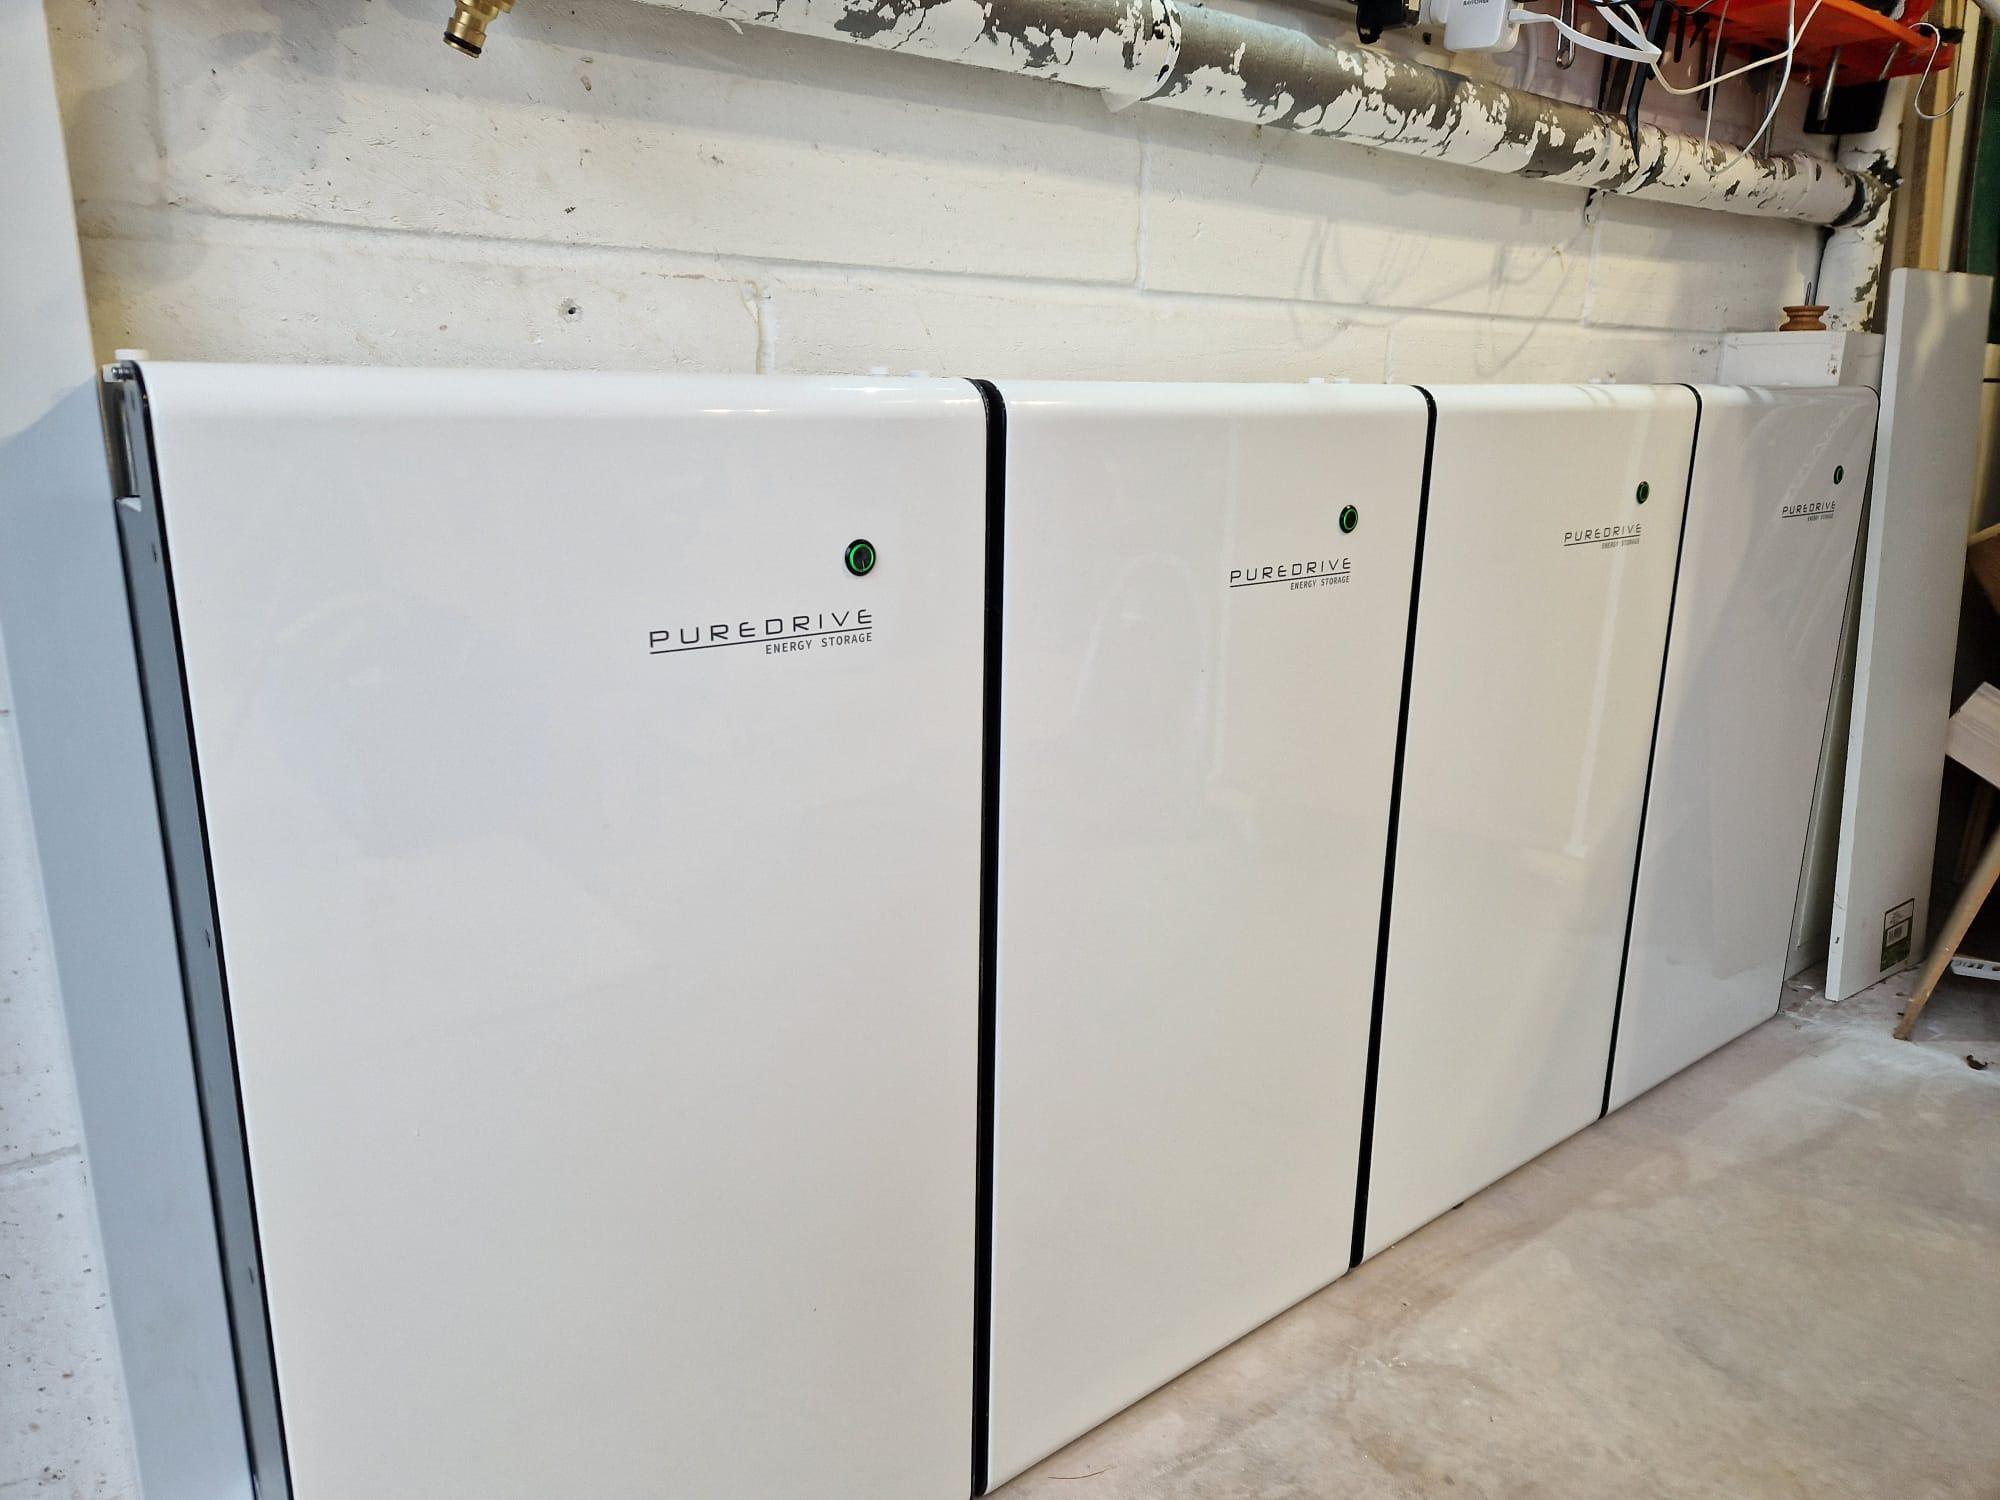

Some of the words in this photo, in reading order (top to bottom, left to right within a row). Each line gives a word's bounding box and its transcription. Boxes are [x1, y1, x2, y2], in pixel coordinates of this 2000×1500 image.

[1781, 501, 1836, 515] PUREDRIVE
[1563, 523, 1642, 543] PUREDRIVE
[1229, 557, 1352, 583] PUREDRIVE
[1290, 579, 1317, 591] ENERGY
[1320, 575, 1351, 587] STORAGE
[649, 608, 873, 648] PUREDRIVE
[765, 639, 813, 655] ENERGY
[820, 632, 873, 648] STORAGE
